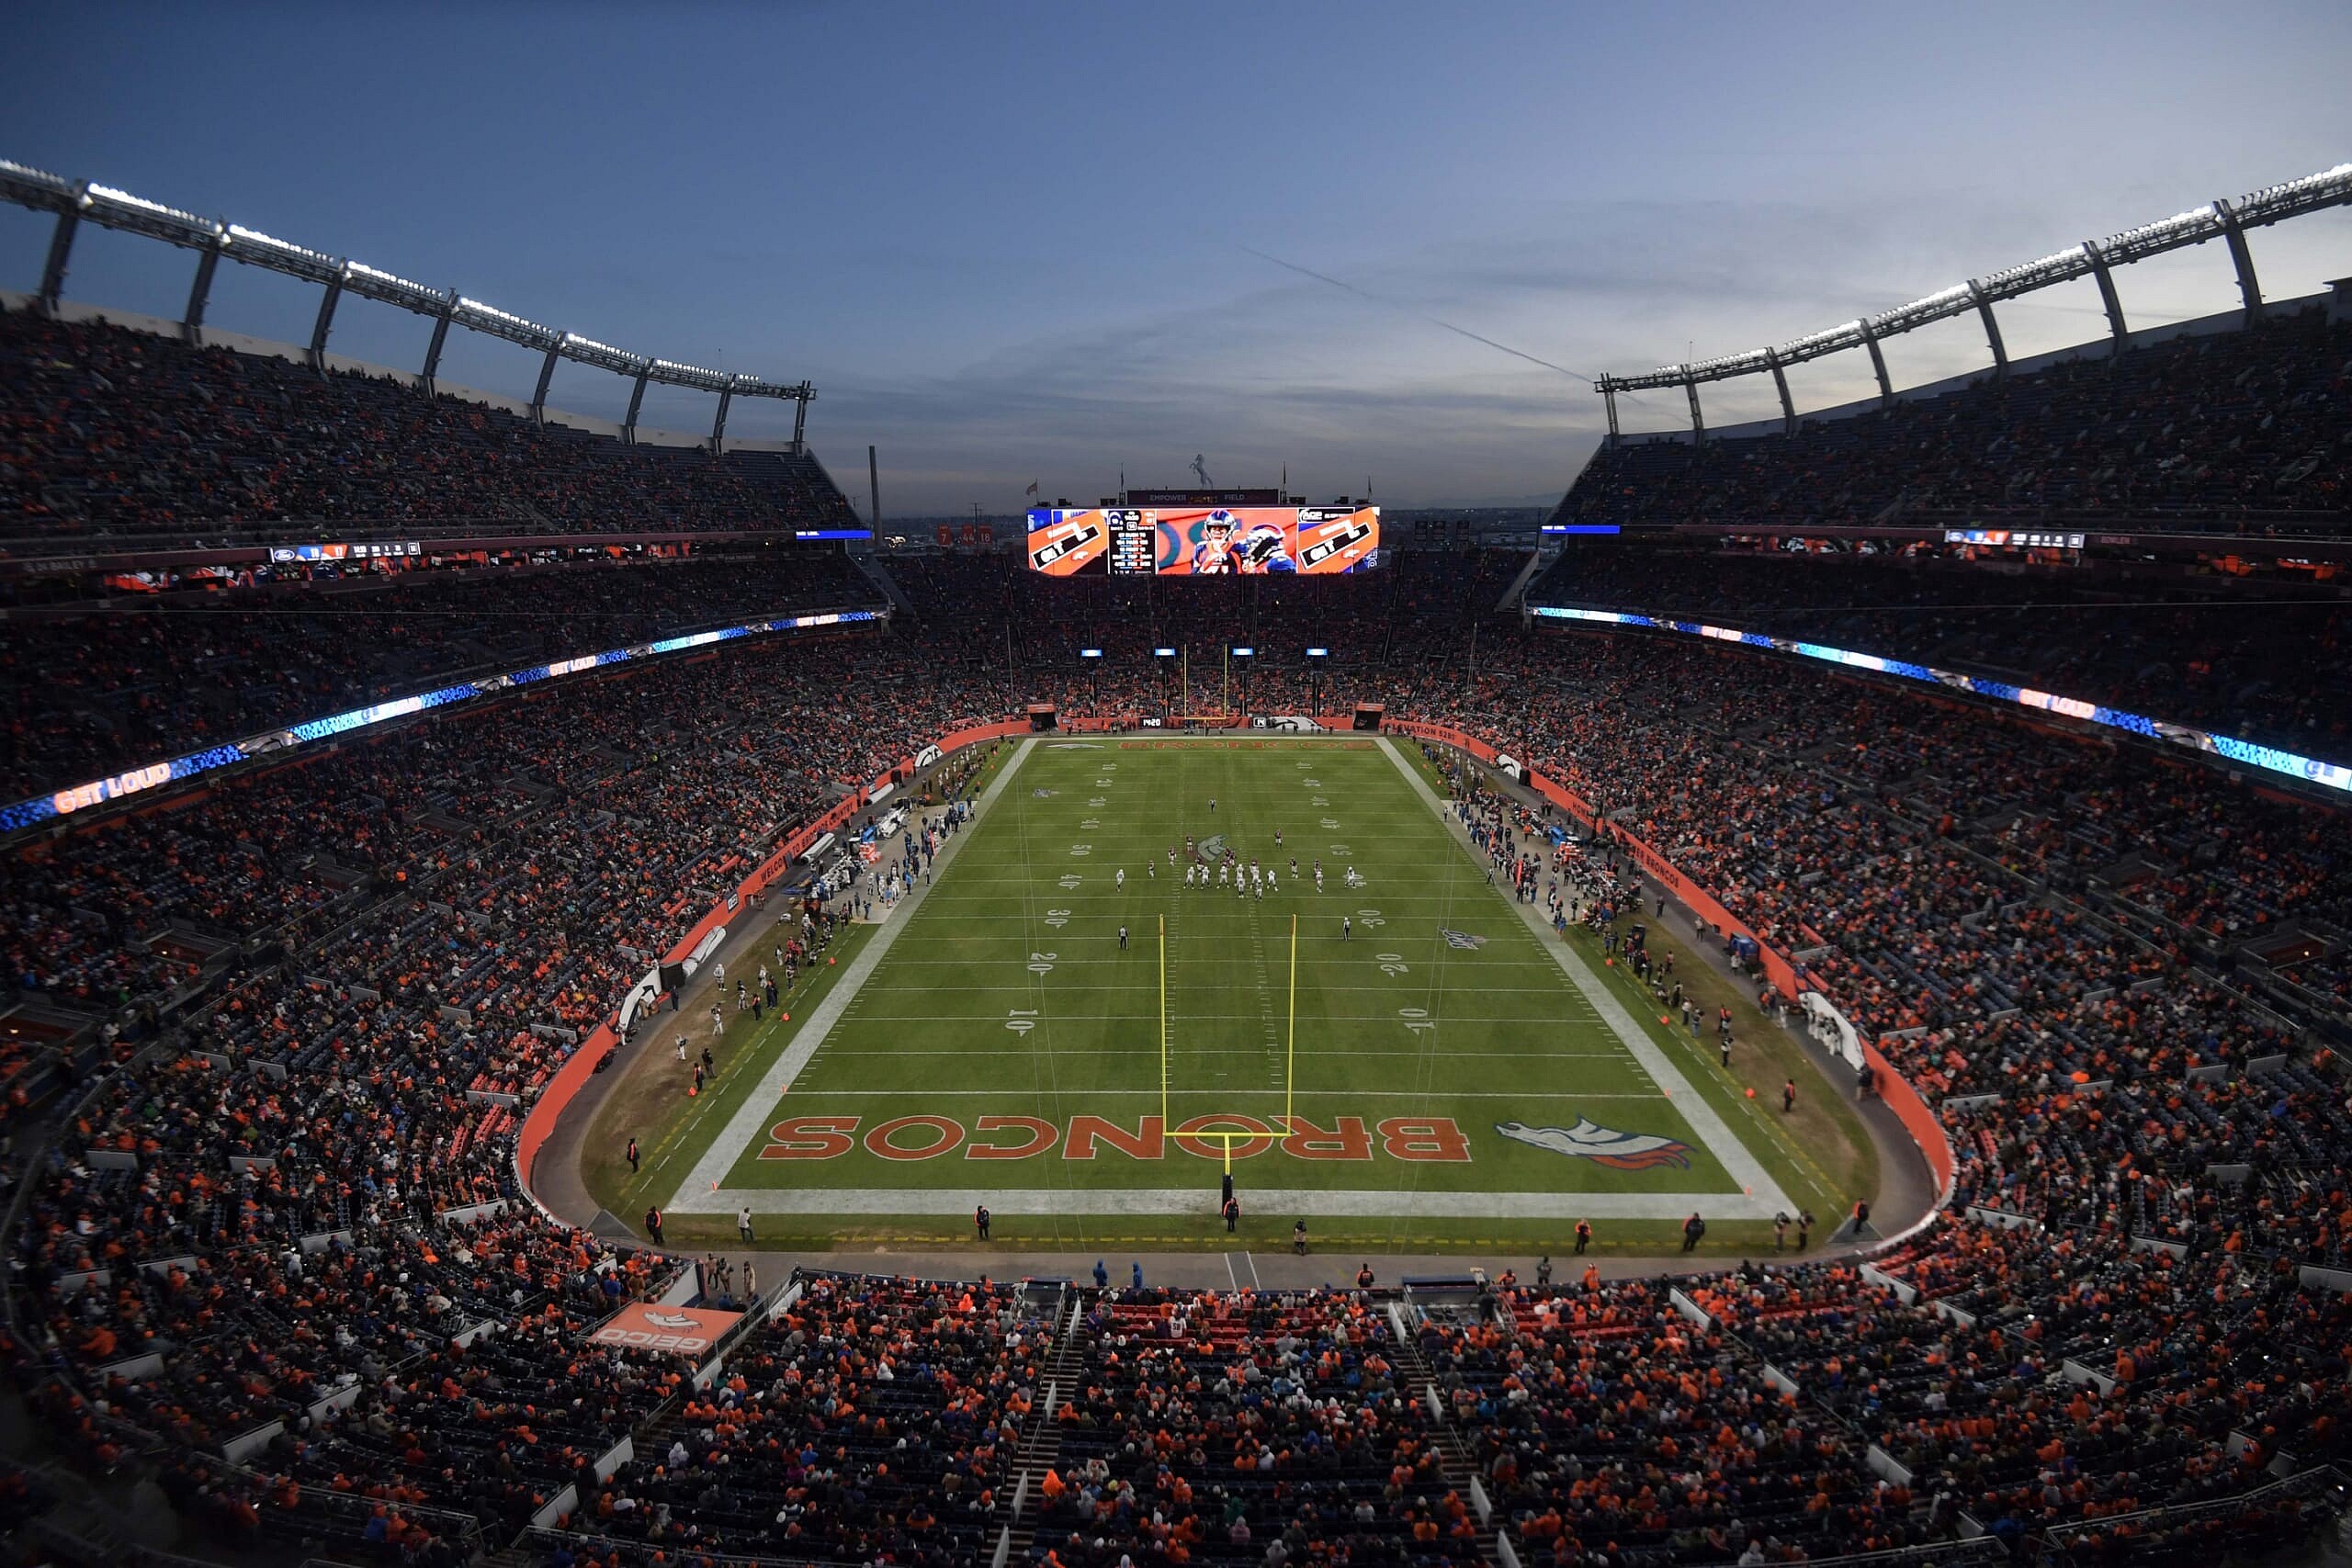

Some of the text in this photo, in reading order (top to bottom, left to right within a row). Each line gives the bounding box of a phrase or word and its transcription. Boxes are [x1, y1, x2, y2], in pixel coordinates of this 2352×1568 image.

[1385, 723, 1436, 735] LVATION
[54, 762, 171, 814] GET LOUD
[1069, 844, 1092, 856] 50
[1057, 874, 1083, 886] 40
[1045, 909, 1071, 925] 30
[1357, 909, 1385, 925] 30
[1026, 952, 1057, 971] 20
[1375, 953, 1409, 973] 20
[1005, 1009, 1038, 1030] 10
[1398, 1008, 1435, 1029] 10
[757, 1114, 1472, 1162] BRONCOS
[597, 1329, 707, 1350] GEICO
